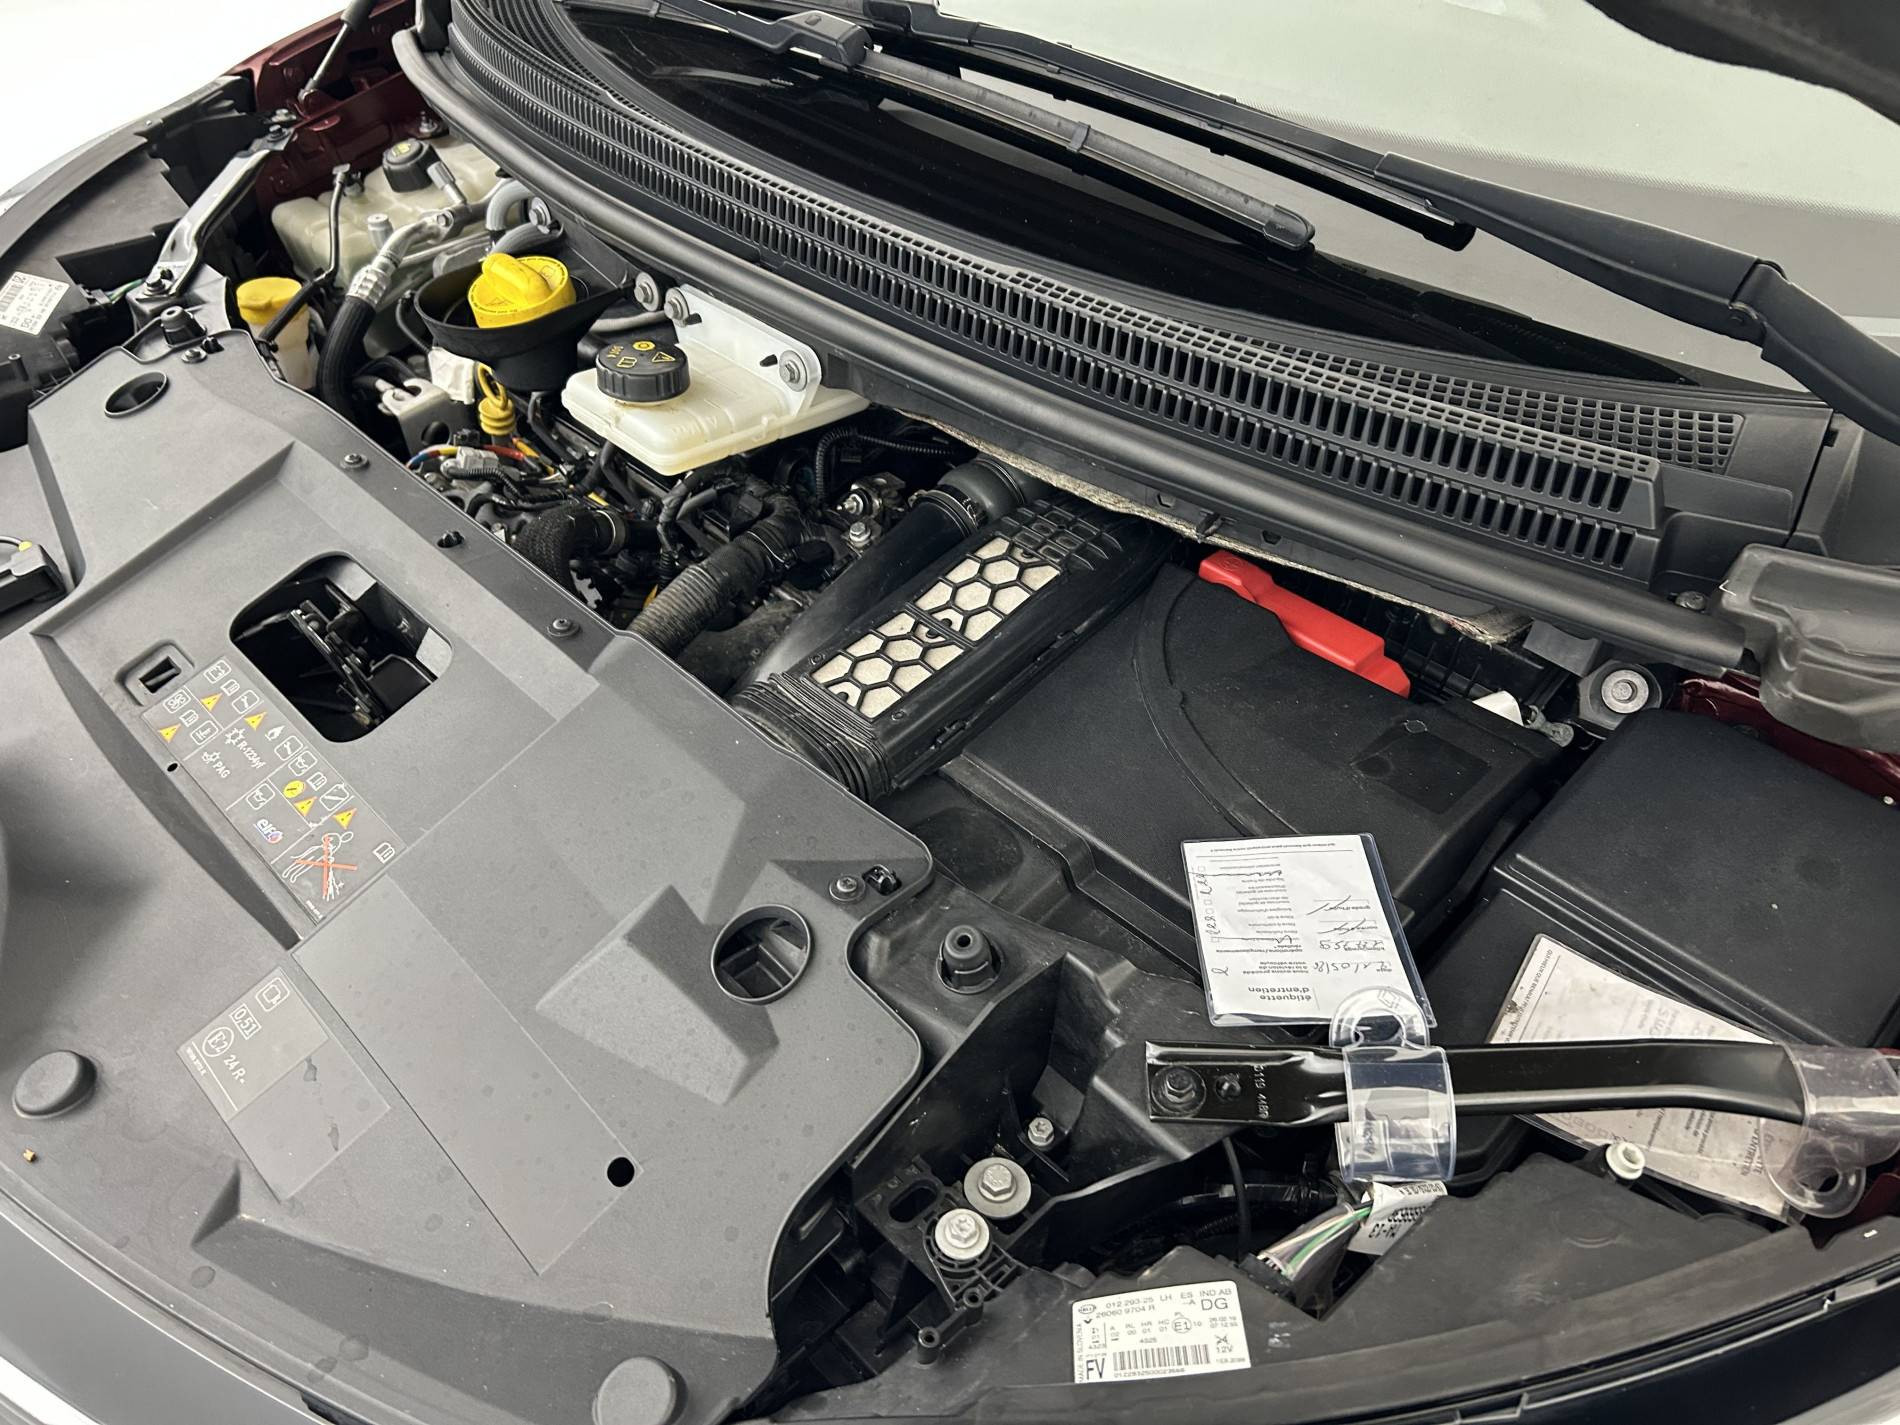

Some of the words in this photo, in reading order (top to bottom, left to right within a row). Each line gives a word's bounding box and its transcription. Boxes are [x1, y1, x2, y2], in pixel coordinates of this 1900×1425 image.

[212, 761, 231, 779] PAG
[234, 1008, 257, 1036] 0,51
[207, 1031, 228, 1053] E2
[1200, 1297, 1229, 1311] DG
[1174, 1321, 1191, 1331] E1
[1216, 1345, 1234, 1353] 12V
[1085, 1357, 1105, 1380] FV
